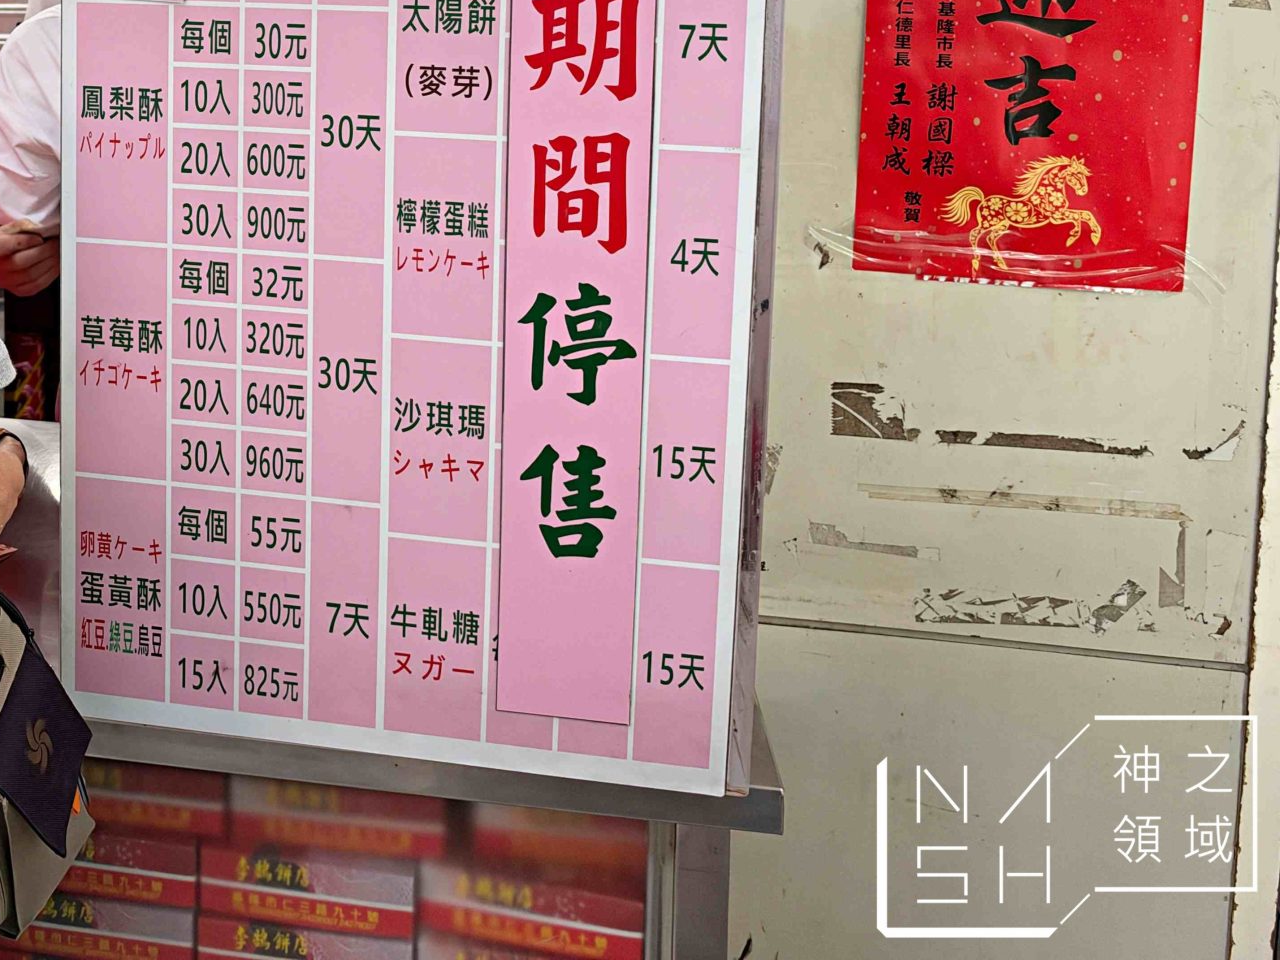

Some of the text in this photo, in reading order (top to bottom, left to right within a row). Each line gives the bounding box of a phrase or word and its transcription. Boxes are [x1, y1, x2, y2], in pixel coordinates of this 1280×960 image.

[179, 19, 231, 55] 每個
[254, 23, 307, 60] 30元
[679, 22, 728, 62] 7天
[894, 0, 914, 67] 仁德里長
[935, 1, 957, 69] 基隆市長
[180, 79, 231, 116] 10入
[251, 81, 303, 118] 300元
[405, 63, 493, 101] (麥芽)
[80, 85, 163, 123] 鳳梨酥
[80, 132, 165, 161] パイナップル
[321, 113, 381, 152] 30天
[180, 141, 231, 178] 20入
[247, 143, 306, 180] 600元
[181, 203, 232, 239] 30入
[247, 205, 306, 243] 900元
[396, 197, 489, 239] 檸檬蛋糕
[904, 191, 922, 223] 敬賀
[396, 246, 490, 280] レモンケーキ
[670, 237, 720, 277] 4天
[179, 258, 229, 296] 每個
[251, 265, 303, 302] 32元
[80, 315, 163, 355] 草莓酥
[183, 317, 227, 353] 10入
[246, 321, 304, 360] 320元
[80, 358, 162, 393] イチゴケーキ
[318, 356, 377, 395] 30天
[179, 378, 229, 415] 20入
[246, 382, 305, 420] 640元
[393, 396, 486, 440] 沙琪瑪
[180, 439, 230, 476] 30入
[246, 445, 304, 483] 960元
[393, 450, 485, 482] シャキマ
[652, 444, 717, 484] 15天
[178, 506, 228, 544] 每個
[251, 516, 302, 554] 55元
[80, 571, 162, 612] 蛋黃酥
[178, 583, 228, 620] 10入
[244, 591, 301, 629] 550元
[326, 602, 369, 639] 7天
[390, 603, 480, 646] 牛軋糖
[179, 658, 227, 695] 15入
[244, 664, 299, 702] 825元
[392, 651, 475, 682] ヌガー
[642, 650, 705, 691] 15天
